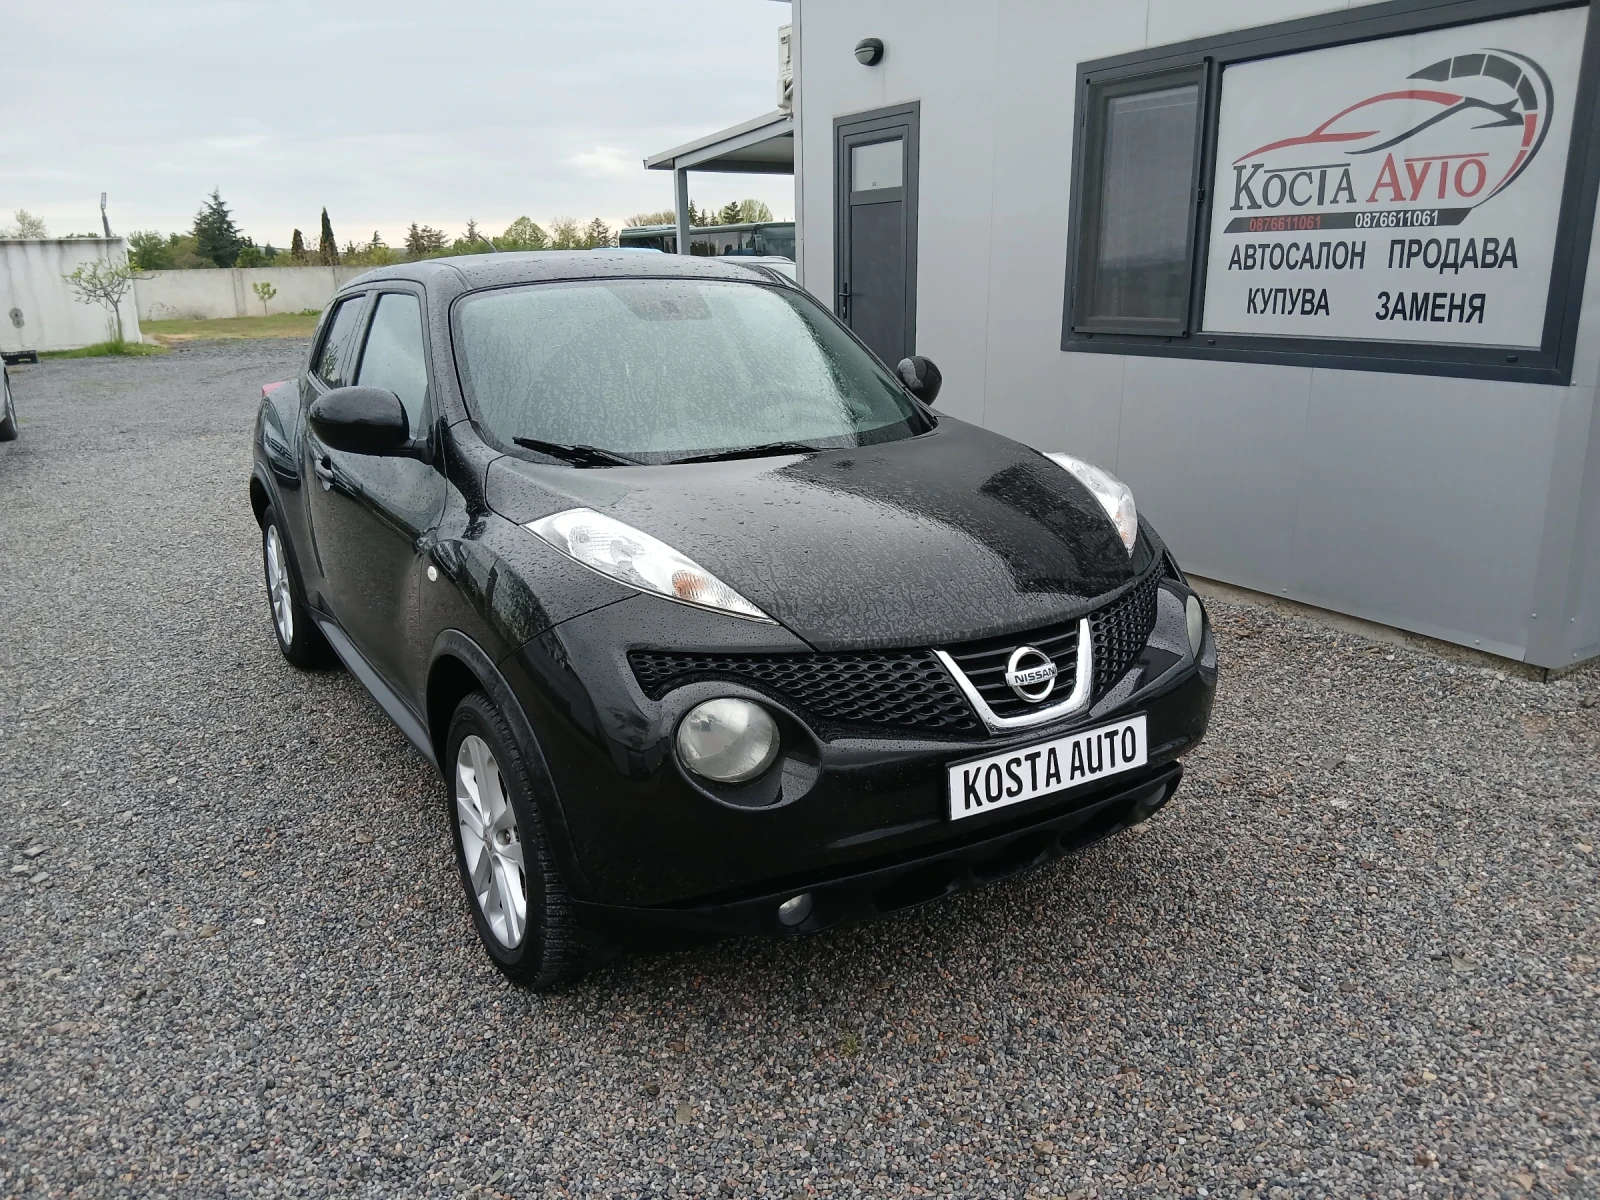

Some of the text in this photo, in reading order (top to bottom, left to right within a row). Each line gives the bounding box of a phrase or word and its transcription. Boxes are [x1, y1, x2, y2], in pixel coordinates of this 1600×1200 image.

[1249, 215, 1321, 232] 0876611061
[1355, 210, 1439, 228] 0876611061
[1228, 237, 1518, 275] АВТОСАЛОН ПРОДАВА
[1247, 288, 1486, 324] КУПУВА ЗАМЕНЯ
[1014, 666, 1056, 684] NISSAN
[963, 725, 1136, 811] KOSTA AUTO
